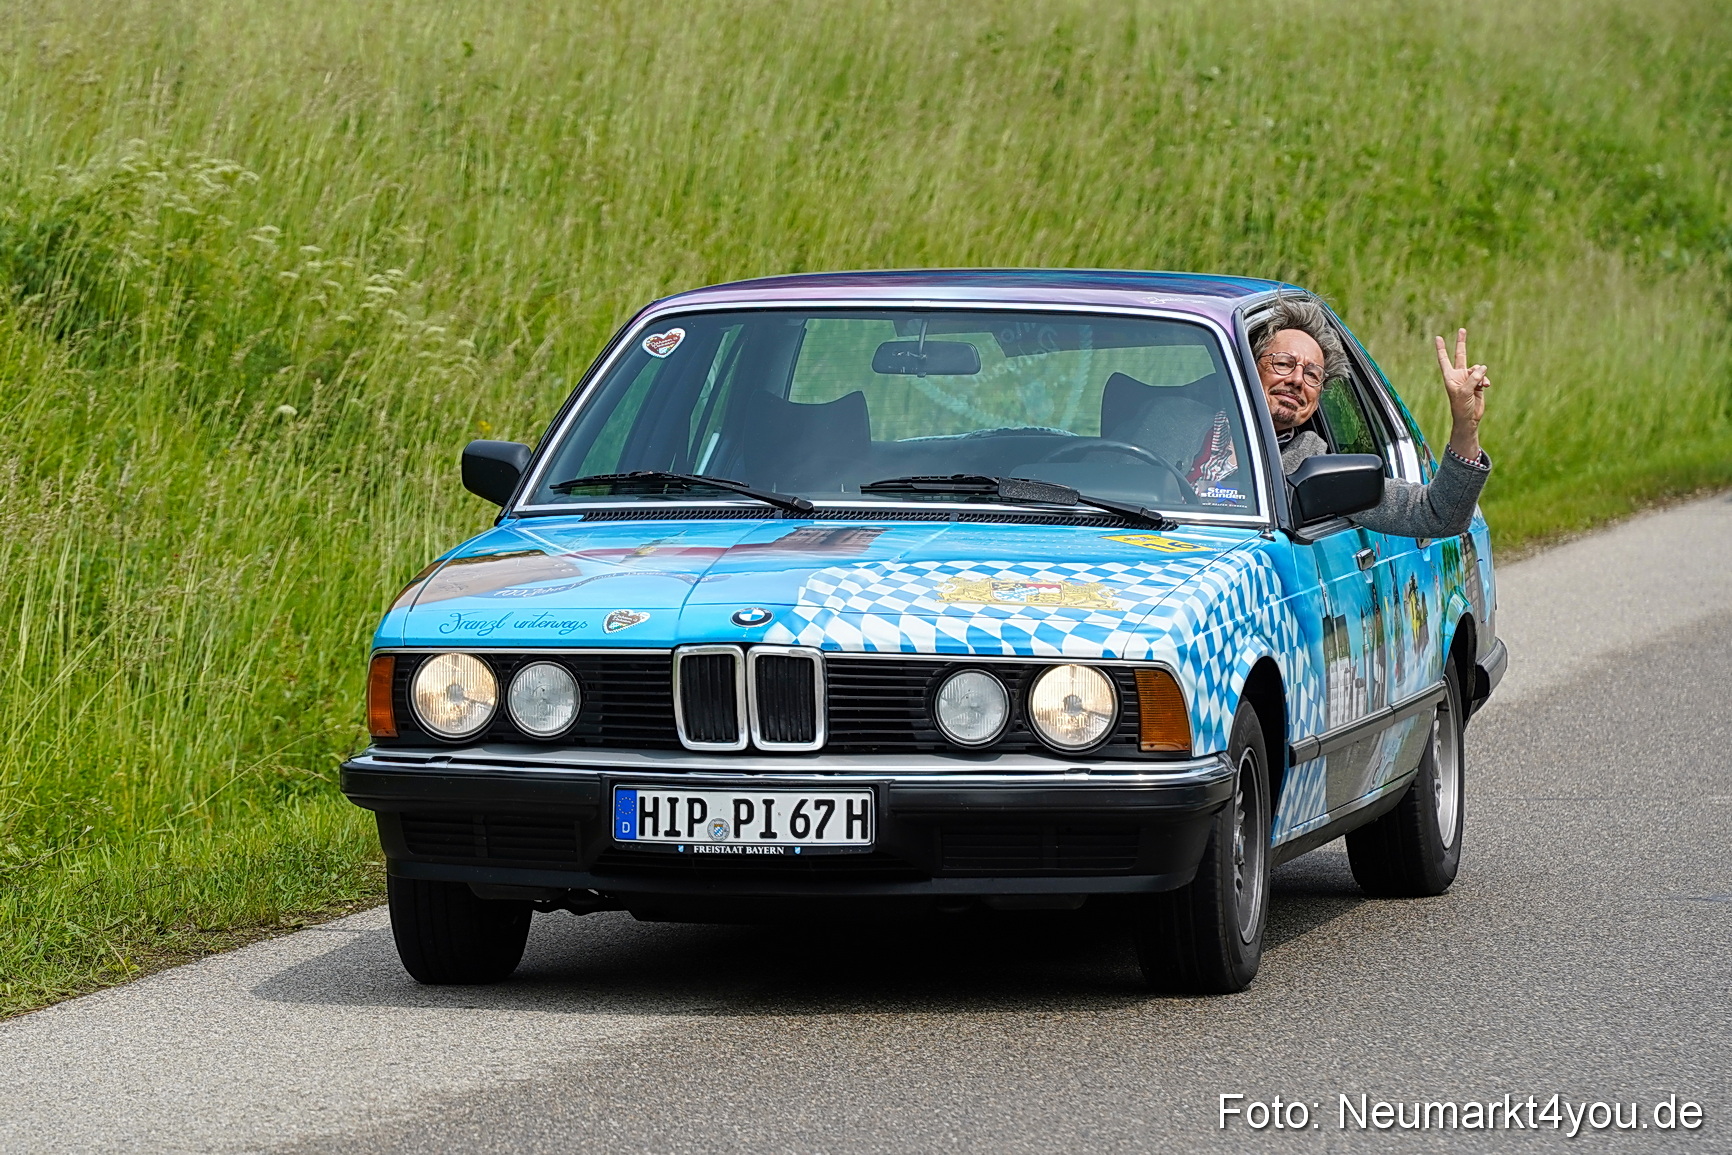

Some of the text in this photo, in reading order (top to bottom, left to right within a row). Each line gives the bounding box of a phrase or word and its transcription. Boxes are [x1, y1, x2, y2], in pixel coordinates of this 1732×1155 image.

[439, 611, 588, 636] Franzl unterwegs
[639, 796, 707, 837] HIP
[732, 798, 777, 839] PI
[621, 821, 630, 834] D
[693, 845, 785, 855] FREISTAAT BAYERN
